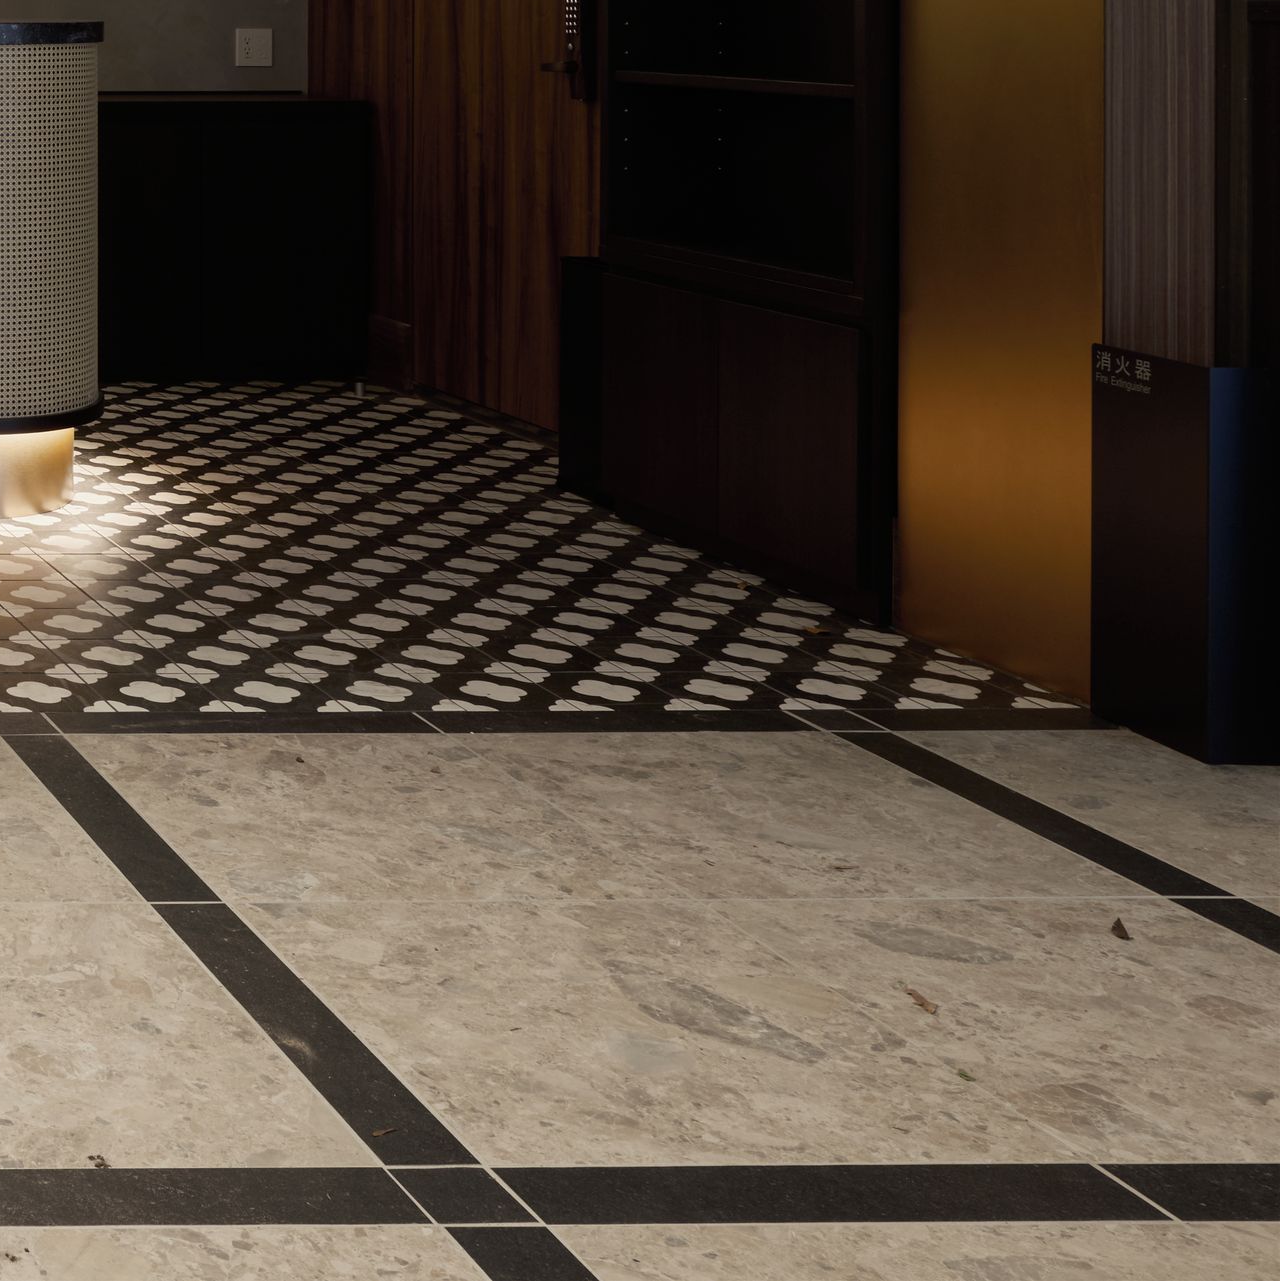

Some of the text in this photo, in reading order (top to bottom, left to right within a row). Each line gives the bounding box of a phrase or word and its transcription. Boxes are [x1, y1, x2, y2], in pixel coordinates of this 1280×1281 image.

[1096, 350, 1152, 381] 消火器
[1095, 372, 1108, 384] Fire
